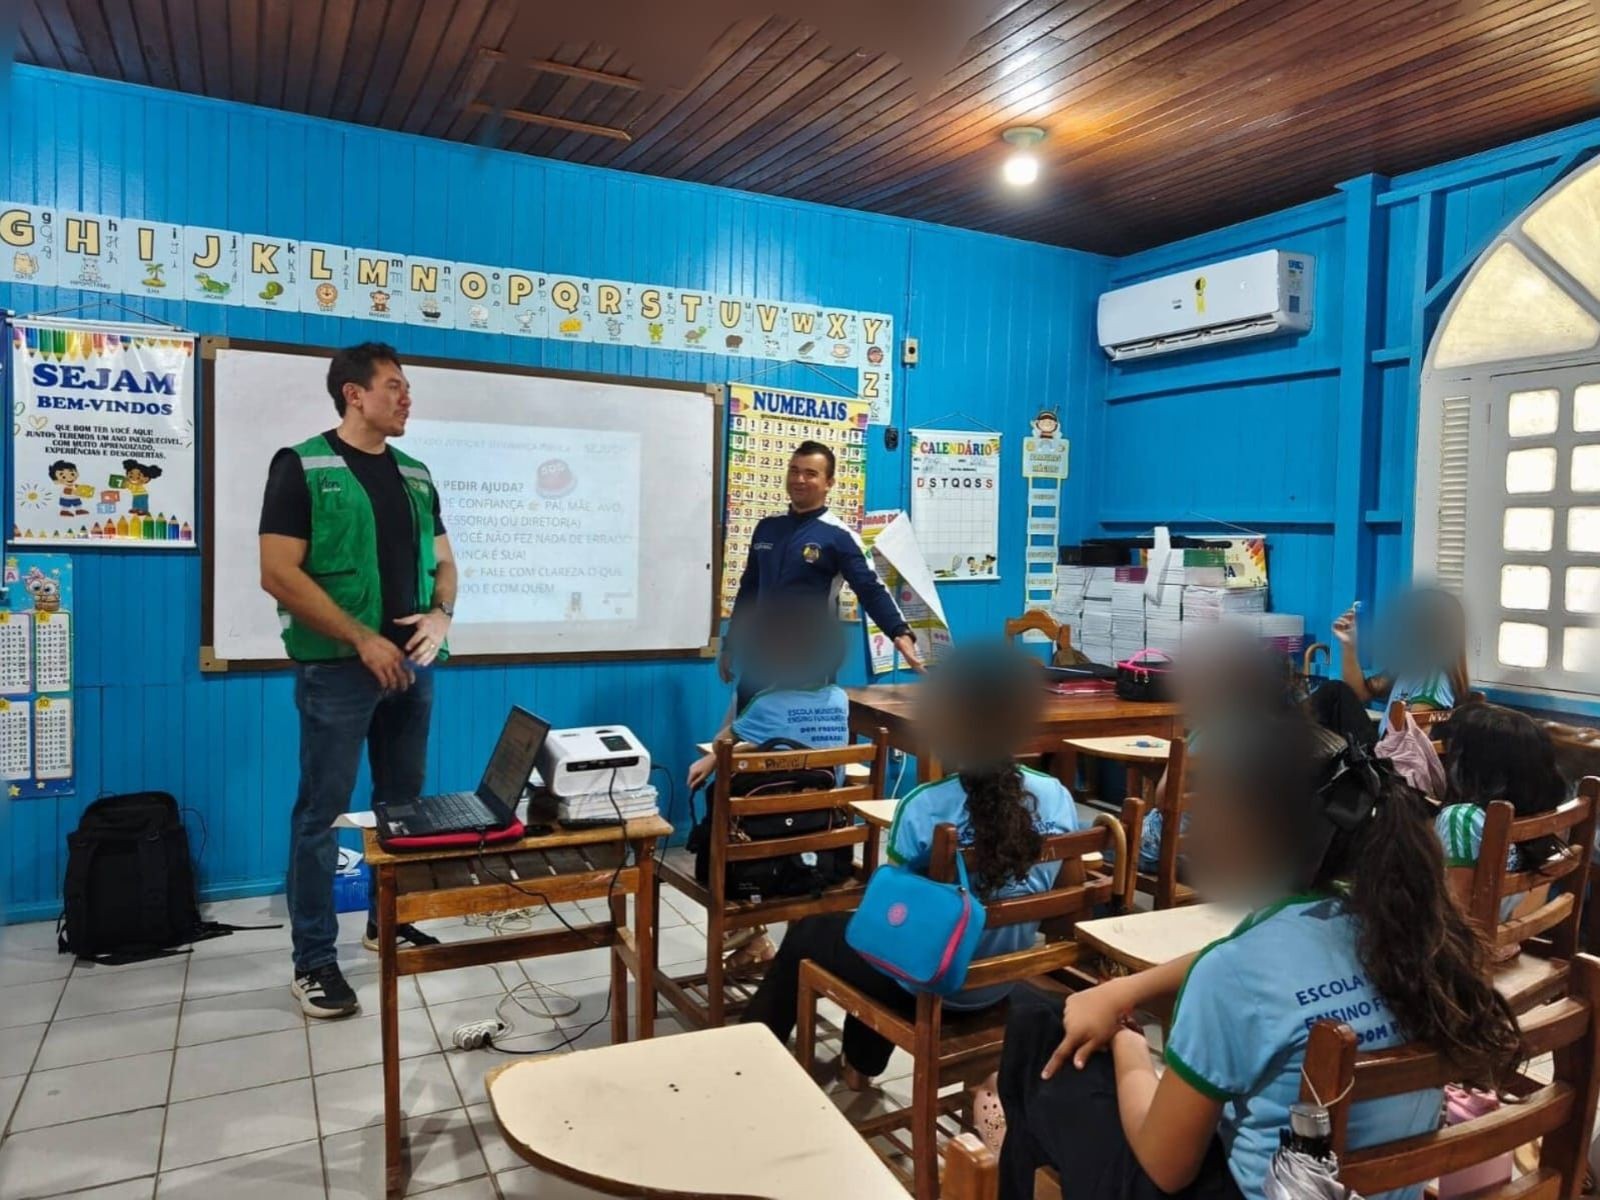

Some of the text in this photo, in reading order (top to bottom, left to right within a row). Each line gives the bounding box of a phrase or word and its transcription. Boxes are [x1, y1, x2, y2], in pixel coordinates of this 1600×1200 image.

[0, 209, 51, 246] G g
[65, 218, 118, 256] H h
[138, 228, 178, 261] I i
[193, 235, 236, 268] J j
[252, 242, 295, 274] K k
[311, 249, 348, 280] L l
[358, 258, 403, 287] M m
[411, 265, 451, 292] N n
[460, 272, 488, 299] O
[509, 275, 546, 305] P p
[552, 281, 589, 313] Q q
[598, 285, 621, 314] R
[641, 290, 661, 319] S
[681, 294, 702, 322] T
[720, 301, 741, 328] U
[757, 304, 778, 332] V
[792, 312, 814, 334] W
[827, 313, 847, 339] X
[863, 318, 882, 344] Y
[33, 363, 177, 396] SEJAM
[864, 372, 880, 398] Z
[37, 395, 173, 416] BEM-VINDOS
[753, 390, 848, 422] NUMERAIS
[59, 432, 95, 441] TEREMOS
[97, 433, 109, 441] UM
[111, 426, 130, 434] VOCÊ
[736, 418, 742, 427] 0
[764, 421, 770, 429] 2
[777, 423, 783, 431] 3
[803, 426, 809, 434] 5
[73, 440, 97, 448] MUITO
[920, 440, 992, 457] CALENDÁRIO
[443, 480, 478, 492] PEDIR
[480, 481, 524, 494] AJUDA?
[917, 478, 993, 489] D S T Q Q S S
[458, 498, 524, 513] CONFIANÇA
[447, 515, 581, 528] ESSOR(A) OU DIRETOR(A)
[486, 530, 511, 543] NÃO
[514, 532, 533, 543] FEZ
[536, 533, 568, 544] NADA
[481, 568, 506, 577] FALE
[509, 568, 536, 577] COM
[538, 568, 584, 577] CLAREZA
[492, 584, 518, 593] COM
[1295, 974, 1364, 1007] ESCOLA
[1357, 1021, 1388, 1046] DOM
